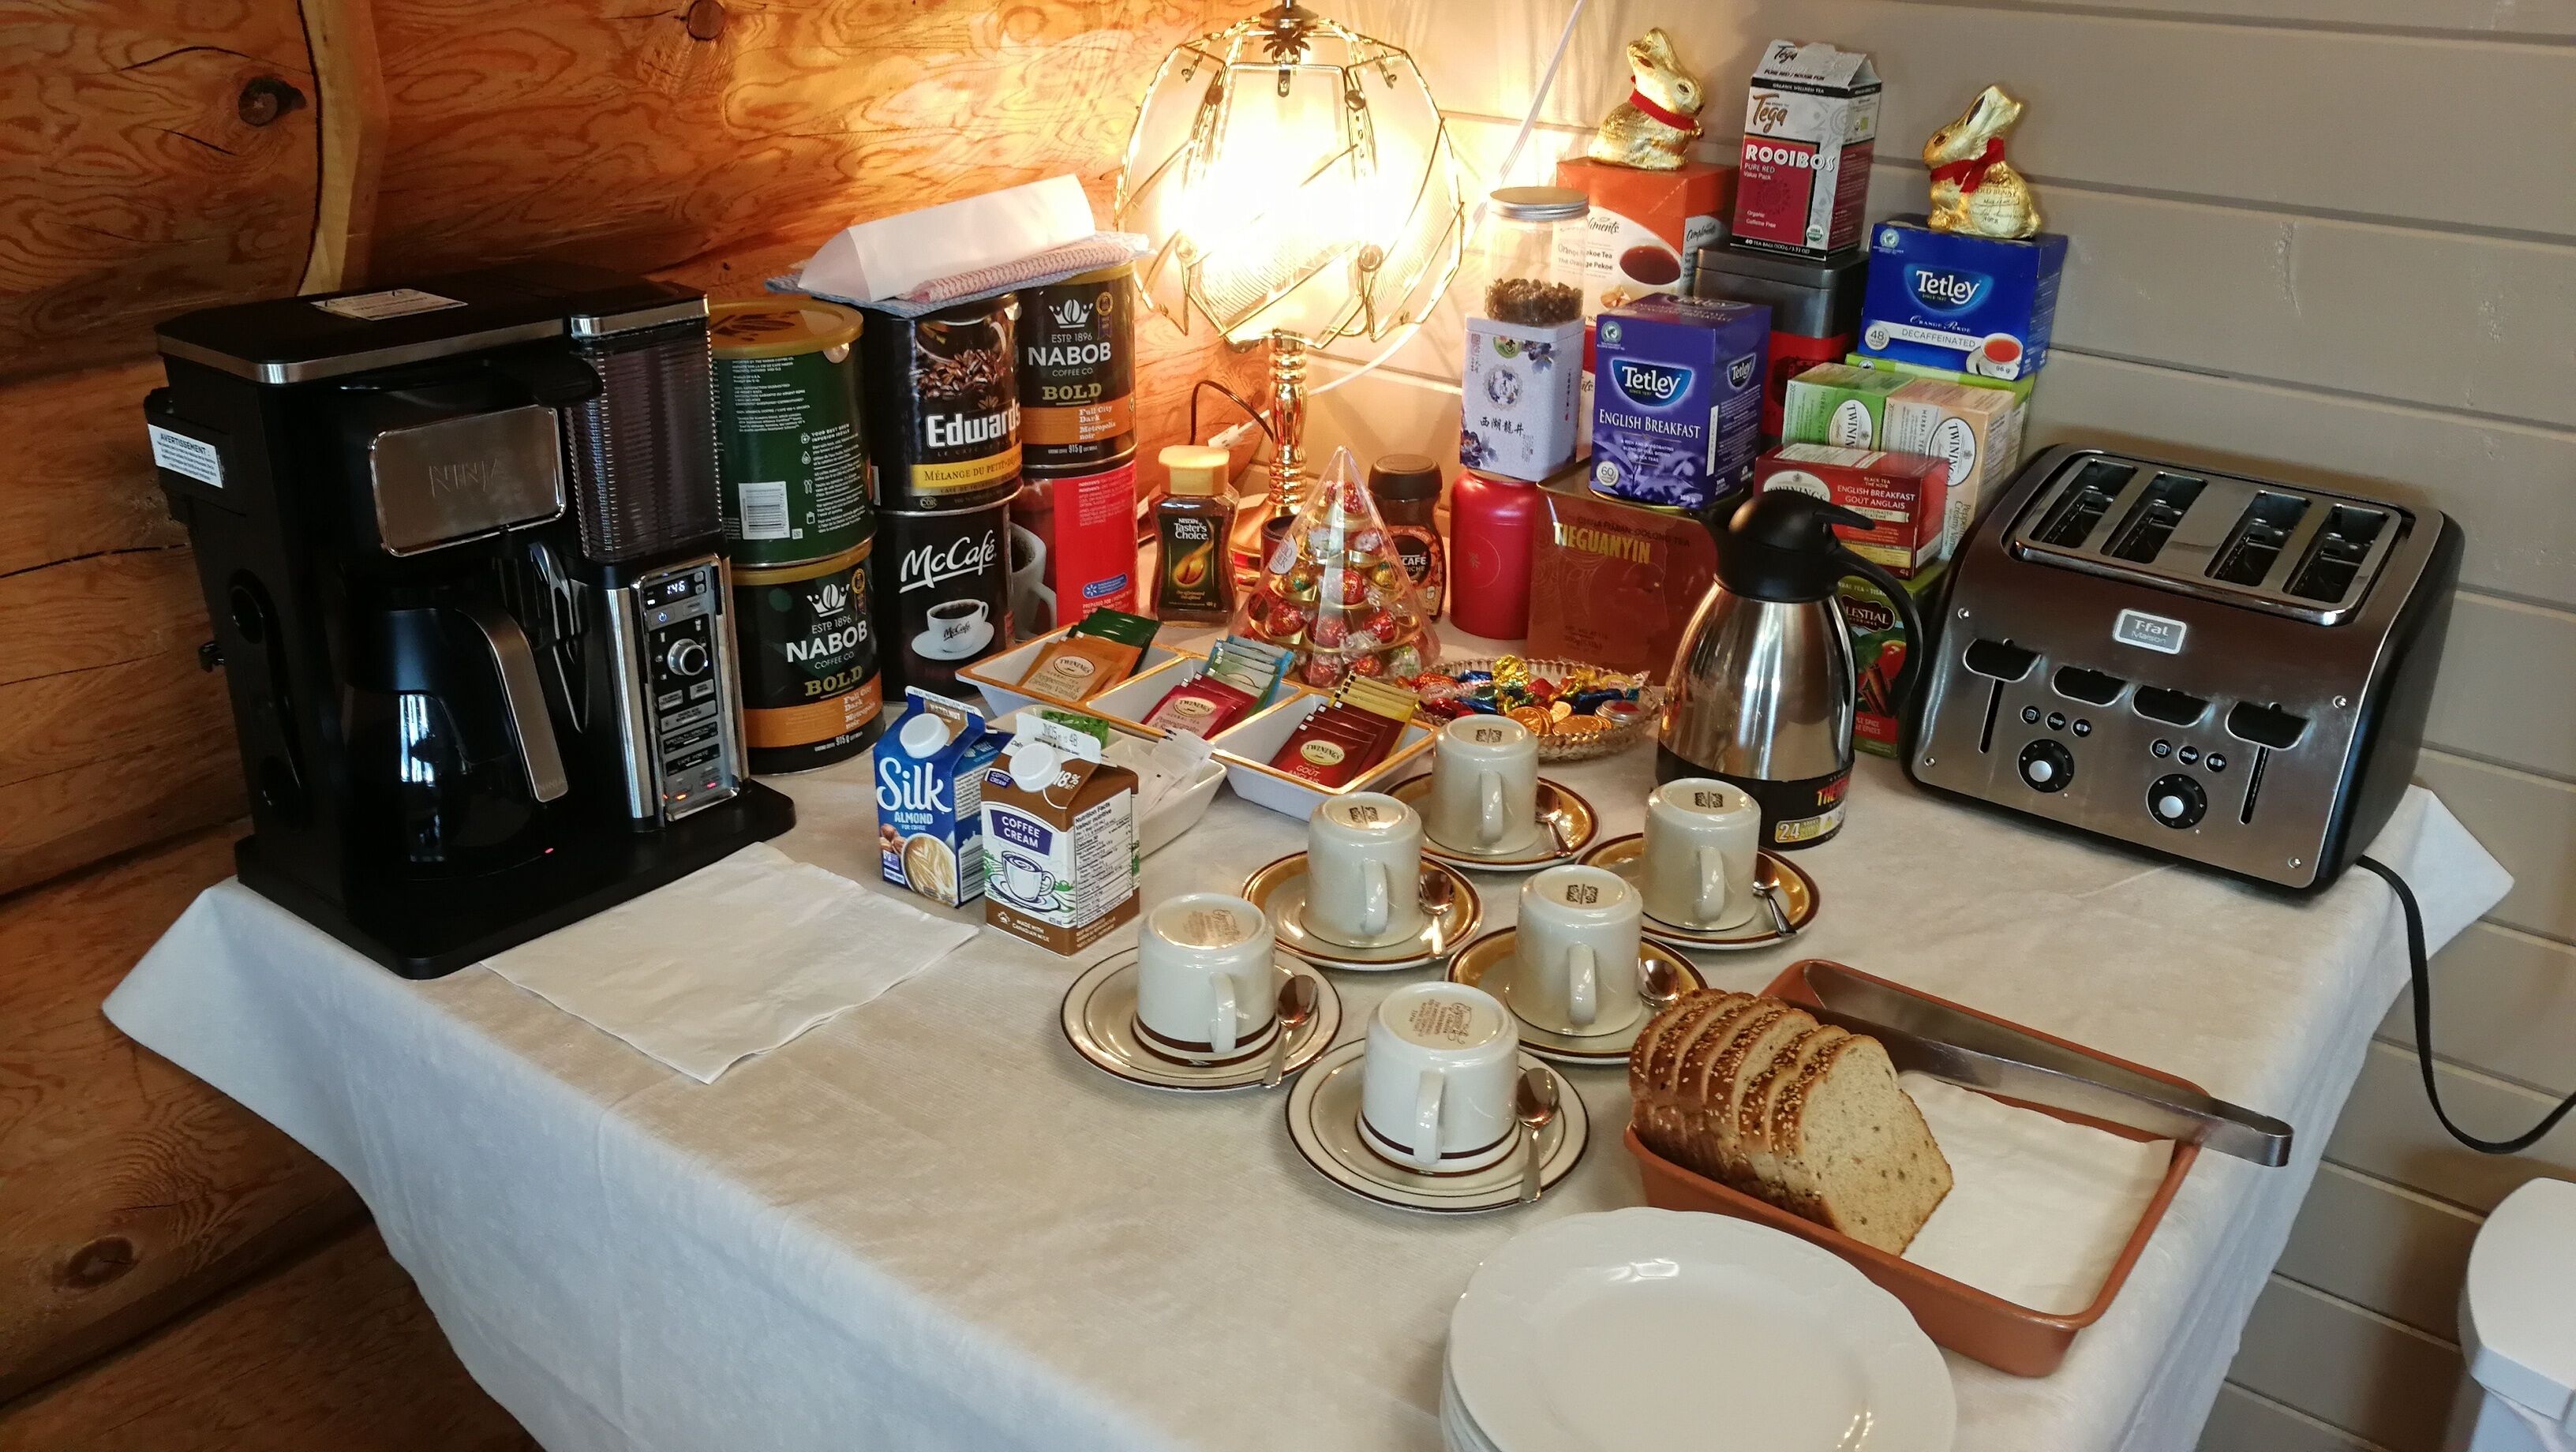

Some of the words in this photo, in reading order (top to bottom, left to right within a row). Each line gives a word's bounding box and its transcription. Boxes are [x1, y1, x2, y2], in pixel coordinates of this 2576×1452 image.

[1773, 44, 1798, 64] Tega
[1753, 92, 1788, 133] Tega
[1746, 144, 1837, 172] ROOIBOS
[1744, 162, 1761, 172] PURE
[1762, 165, 1775, 174] RED
[1747, 210, 1765, 219] Organic
[1601, 251, 1612, 260] Tea
[1593, 262, 1613, 271] Pekoe
[1916, 270, 1982, 305] Tetley
[1074, 332, 1093, 342] 1896
[1870, 330, 1885, 341] 48
[1902, 328, 1975, 348] DECAFFEINATED
[1028, 342, 1111, 366] NABOB
[1052, 369, 1080, 377] COFFEE
[1731, 359, 1753, 380] Tetley
[1621, 365, 1682, 399] Tetley
[1042, 383, 1102, 400] BOLD
[1080, 402, 1097, 415] Full
[927, 398, 1020, 448] Edwards
[1080, 414, 1101, 423] Dark
[1599, 409, 1642, 430] ENGLISH
[1645, 416, 1702, 439] BREAKFAST
[1845, 403, 1858, 448] TWININ
[924, 470, 971, 481] MÉLANGE
[973, 466, 985, 476] DU
[1601, 466, 1614, 476] 60
[1837, 485, 1870, 496] ENGLISH
[1870, 488, 1916, 502] BREAKFAST
[1870, 499, 1906, 510] ANGLAIS
[1174, 522, 1208, 533] Taster's
[1174, 530, 1208, 541] Choice
[1552, 521, 1651, 564] TIEGUANYIN
[900, 530, 995, 589] McCafé
[1402, 550, 1427, 566] CAFÉ
[834, 615, 852, 628] 1896
[1845, 605, 1890, 624] LESTIAL
[2134, 619, 2169, 637] T-fal
[786, 619, 867, 662] NABOB
[2132, 631, 2166, 644] Maison
[814, 656, 843, 669] COFFEE
[1059, 658, 1091, 674] TWININGS
[803, 665, 863, 696] BOLD
[1178, 699, 1212, 712] TWININGS
[1306, 744, 1342, 761] TWININGS
[877, 757, 953, 813] Silk
[990, 777, 1007, 787] CREAM
[991, 771, 1010, 783] COFFEE
[894, 811, 934, 825] ALMOND
[1075, 807, 1096, 824] Nutrition
[1096, 802, 1111, 814] Facts
[1002, 815, 1040, 838] COFFEE
[1778, 822, 1800, 840] 24
[1003, 829, 1039, 848] CREAM
